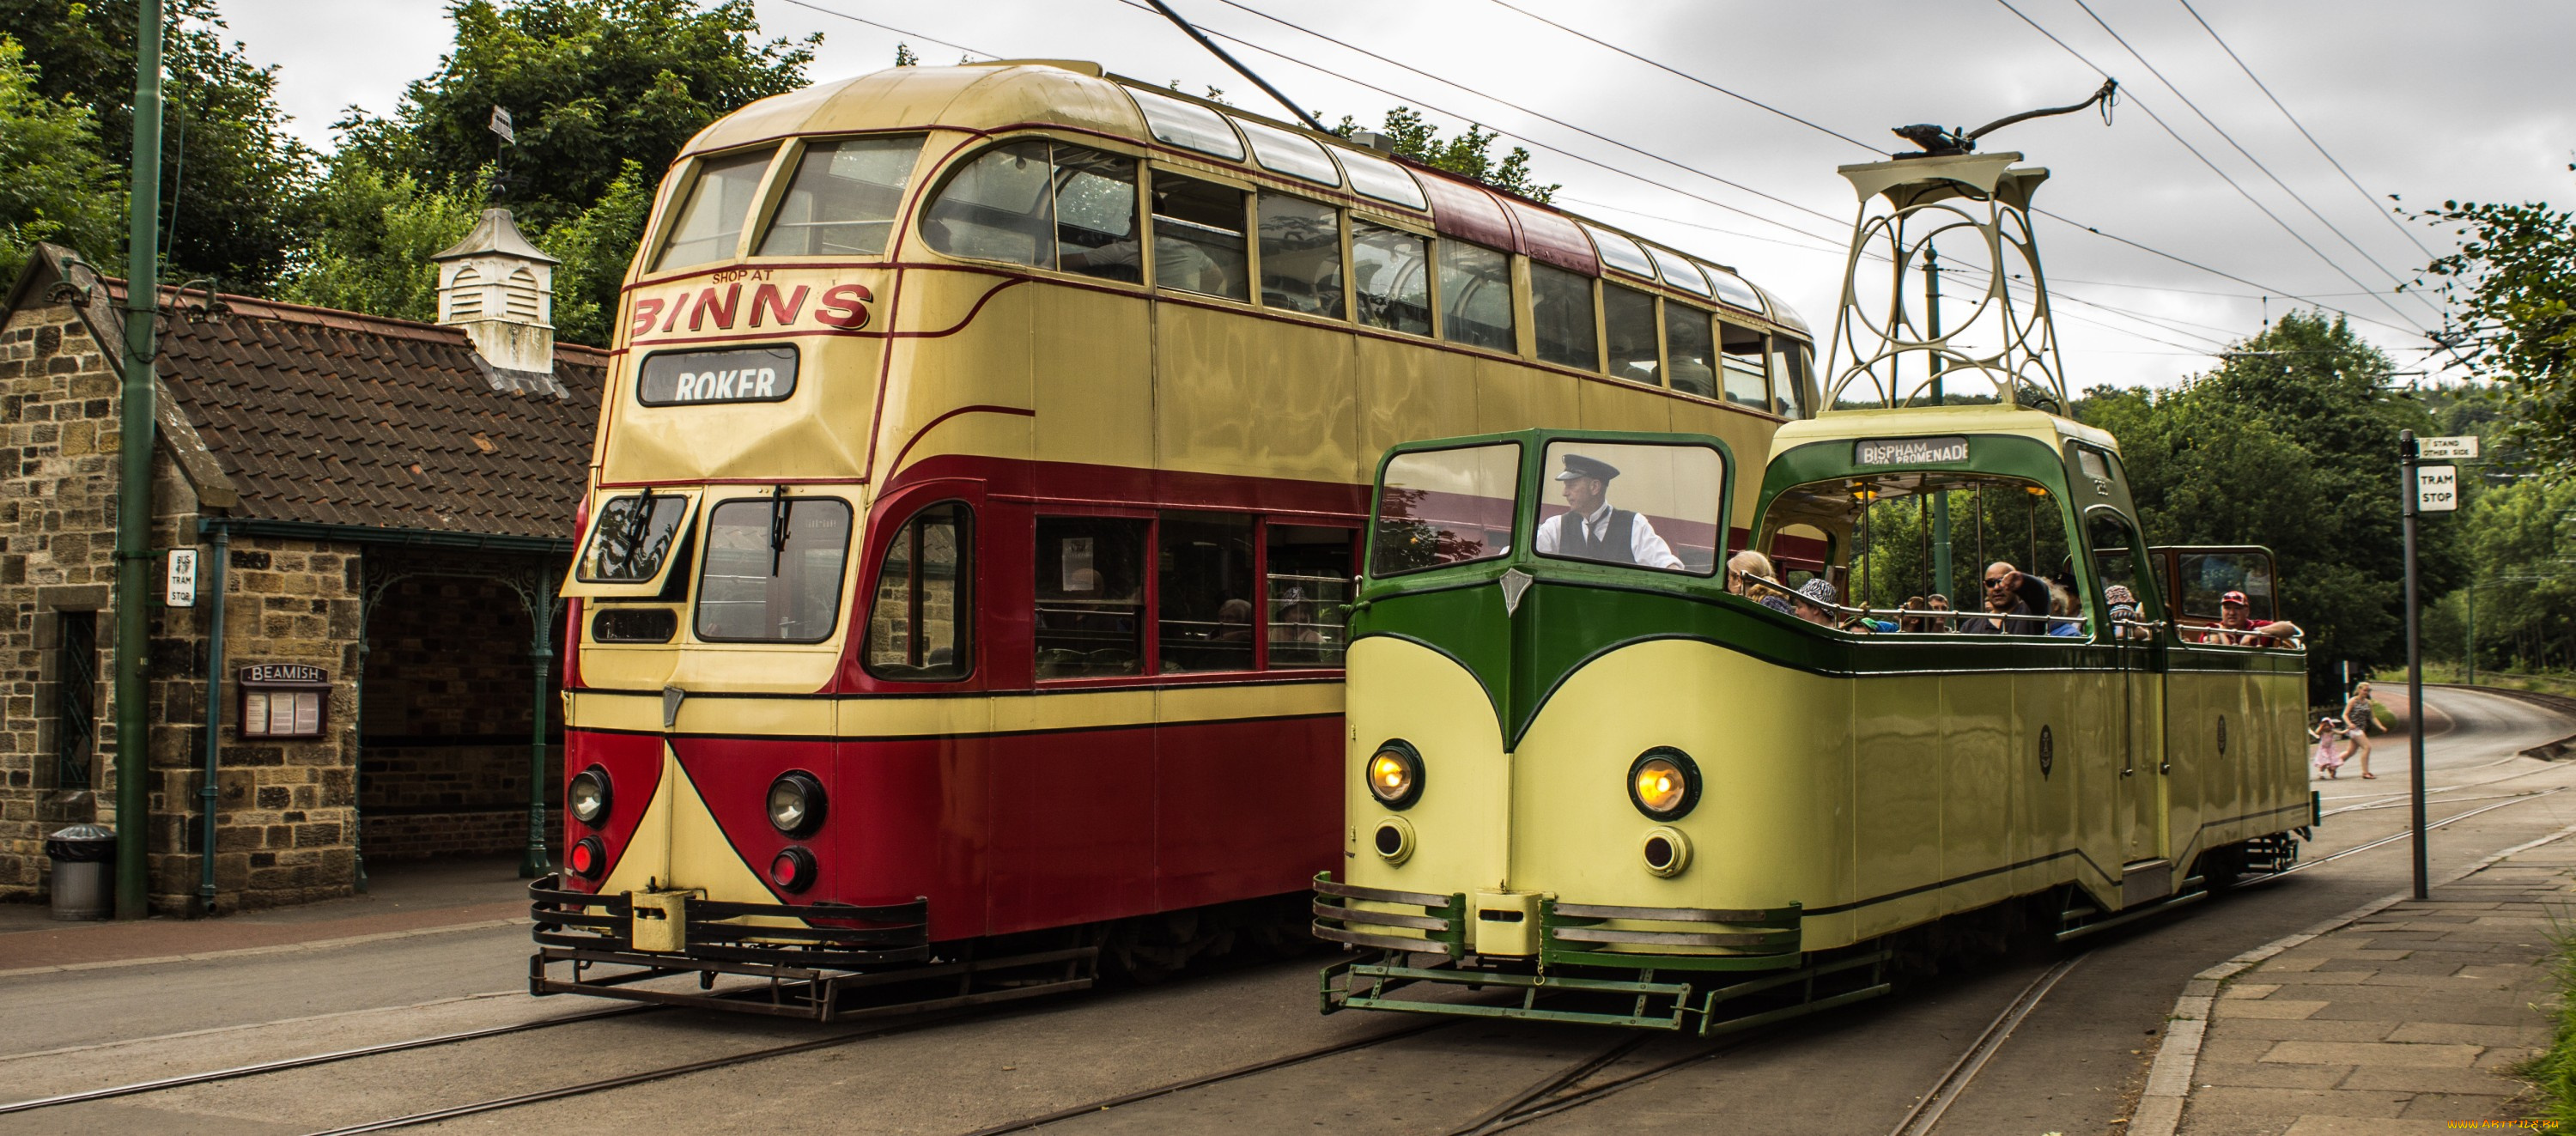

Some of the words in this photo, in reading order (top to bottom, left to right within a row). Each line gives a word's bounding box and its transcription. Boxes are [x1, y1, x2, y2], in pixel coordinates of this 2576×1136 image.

[713, 270, 748, 284] SHOP
[750, 269, 774, 281] AT
[632, 282, 873, 336] BINNS
[676, 368, 776, 400] ROKER
[1863, 442, 1928, 464] BISPHAM
[1896, 443, 1968, 464] PROMENADE
[2421, 476, 2453, 484] TRAM
[2422, 493, 2452, 501] STOP
[172, 576, 191, 585] TRAM
[172, 592, 191, 601] STOP
[252, 665, 319, 680] BEAMISH
